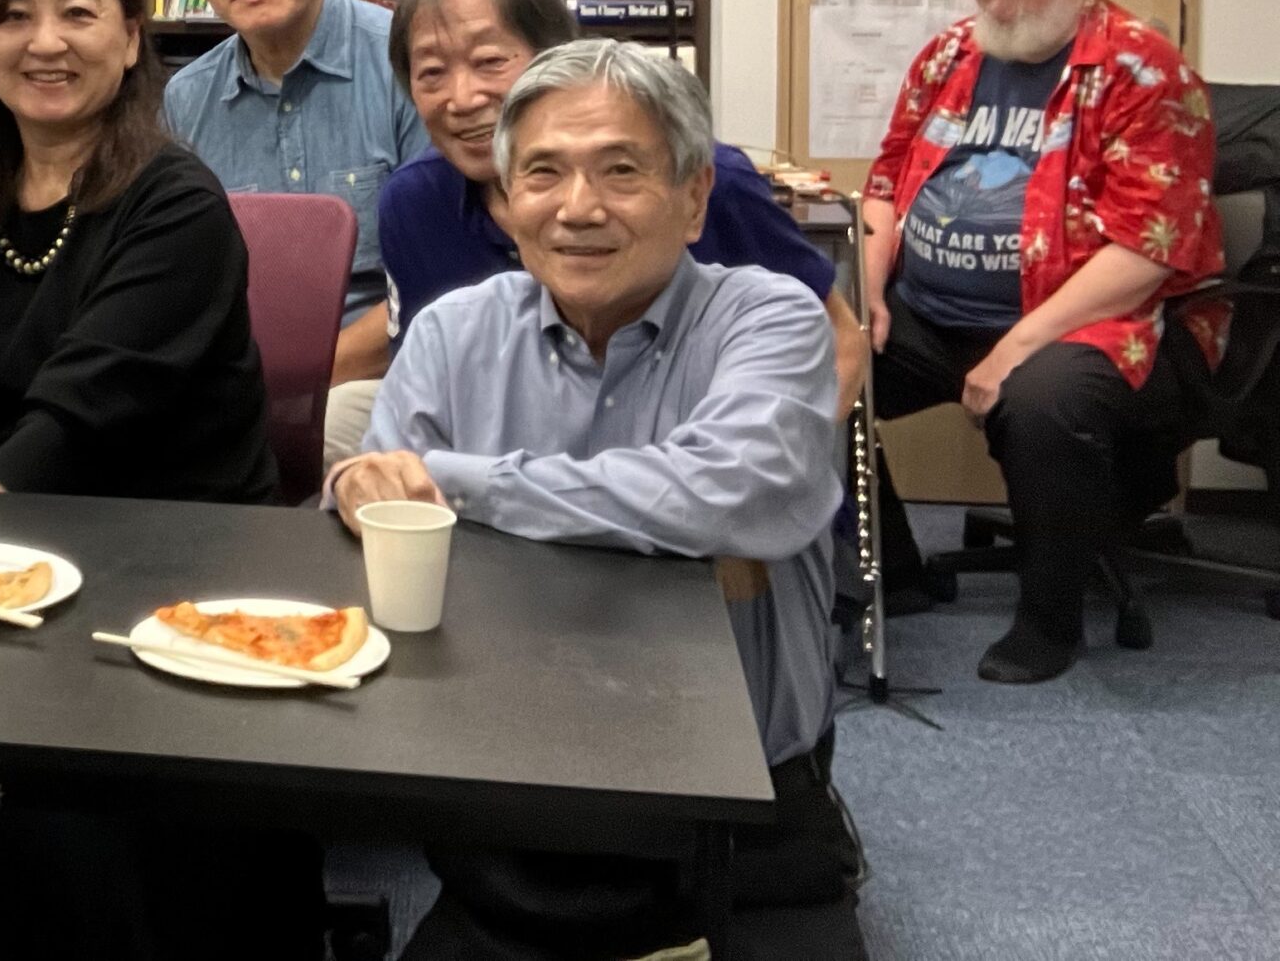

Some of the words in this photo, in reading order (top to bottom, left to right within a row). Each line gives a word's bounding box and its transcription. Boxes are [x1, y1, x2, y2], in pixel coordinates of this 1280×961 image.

[956, 104, 998, 146] M
[947, 232, 985, 251] ARE
[934, 247, 977, 270] TWO
